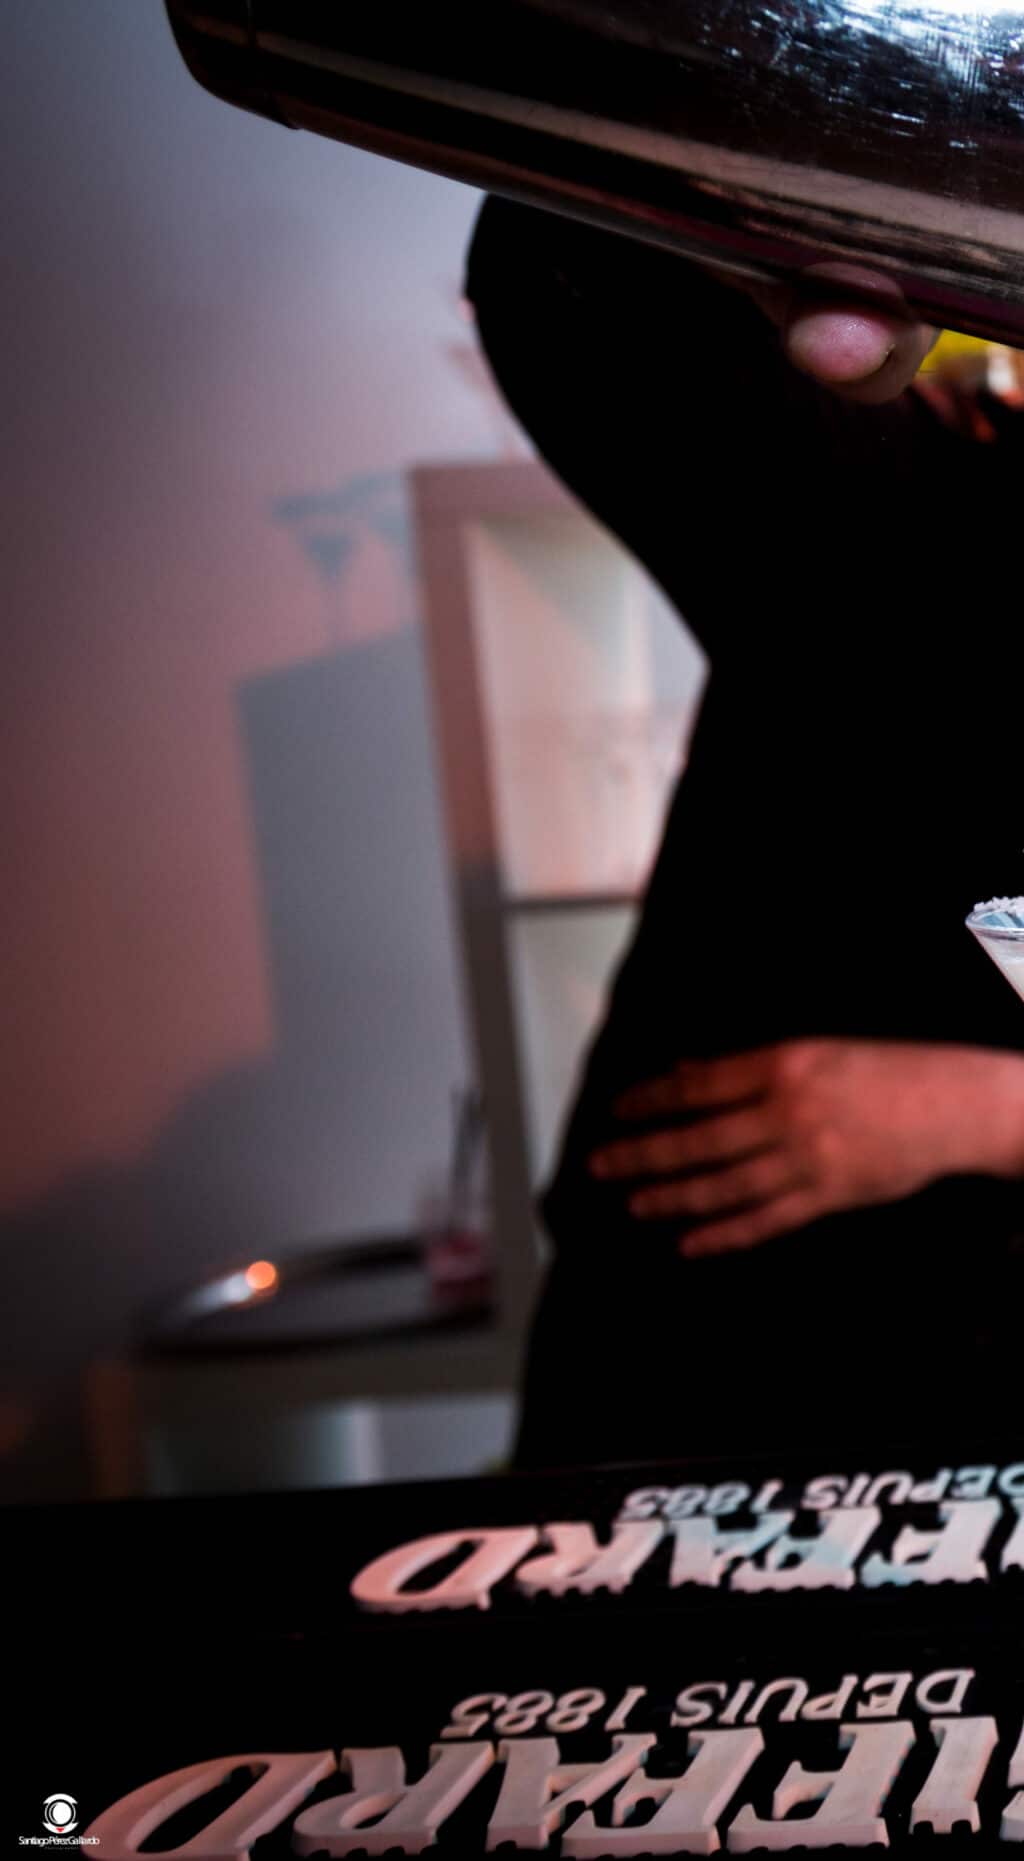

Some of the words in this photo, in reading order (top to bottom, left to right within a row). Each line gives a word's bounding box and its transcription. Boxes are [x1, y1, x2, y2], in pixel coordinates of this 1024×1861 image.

[622, 1480, 782, 1518] 1885
[440, 1685, 647, 1739] 1885
[669, 1668, 976, 1727] DEPUIS
